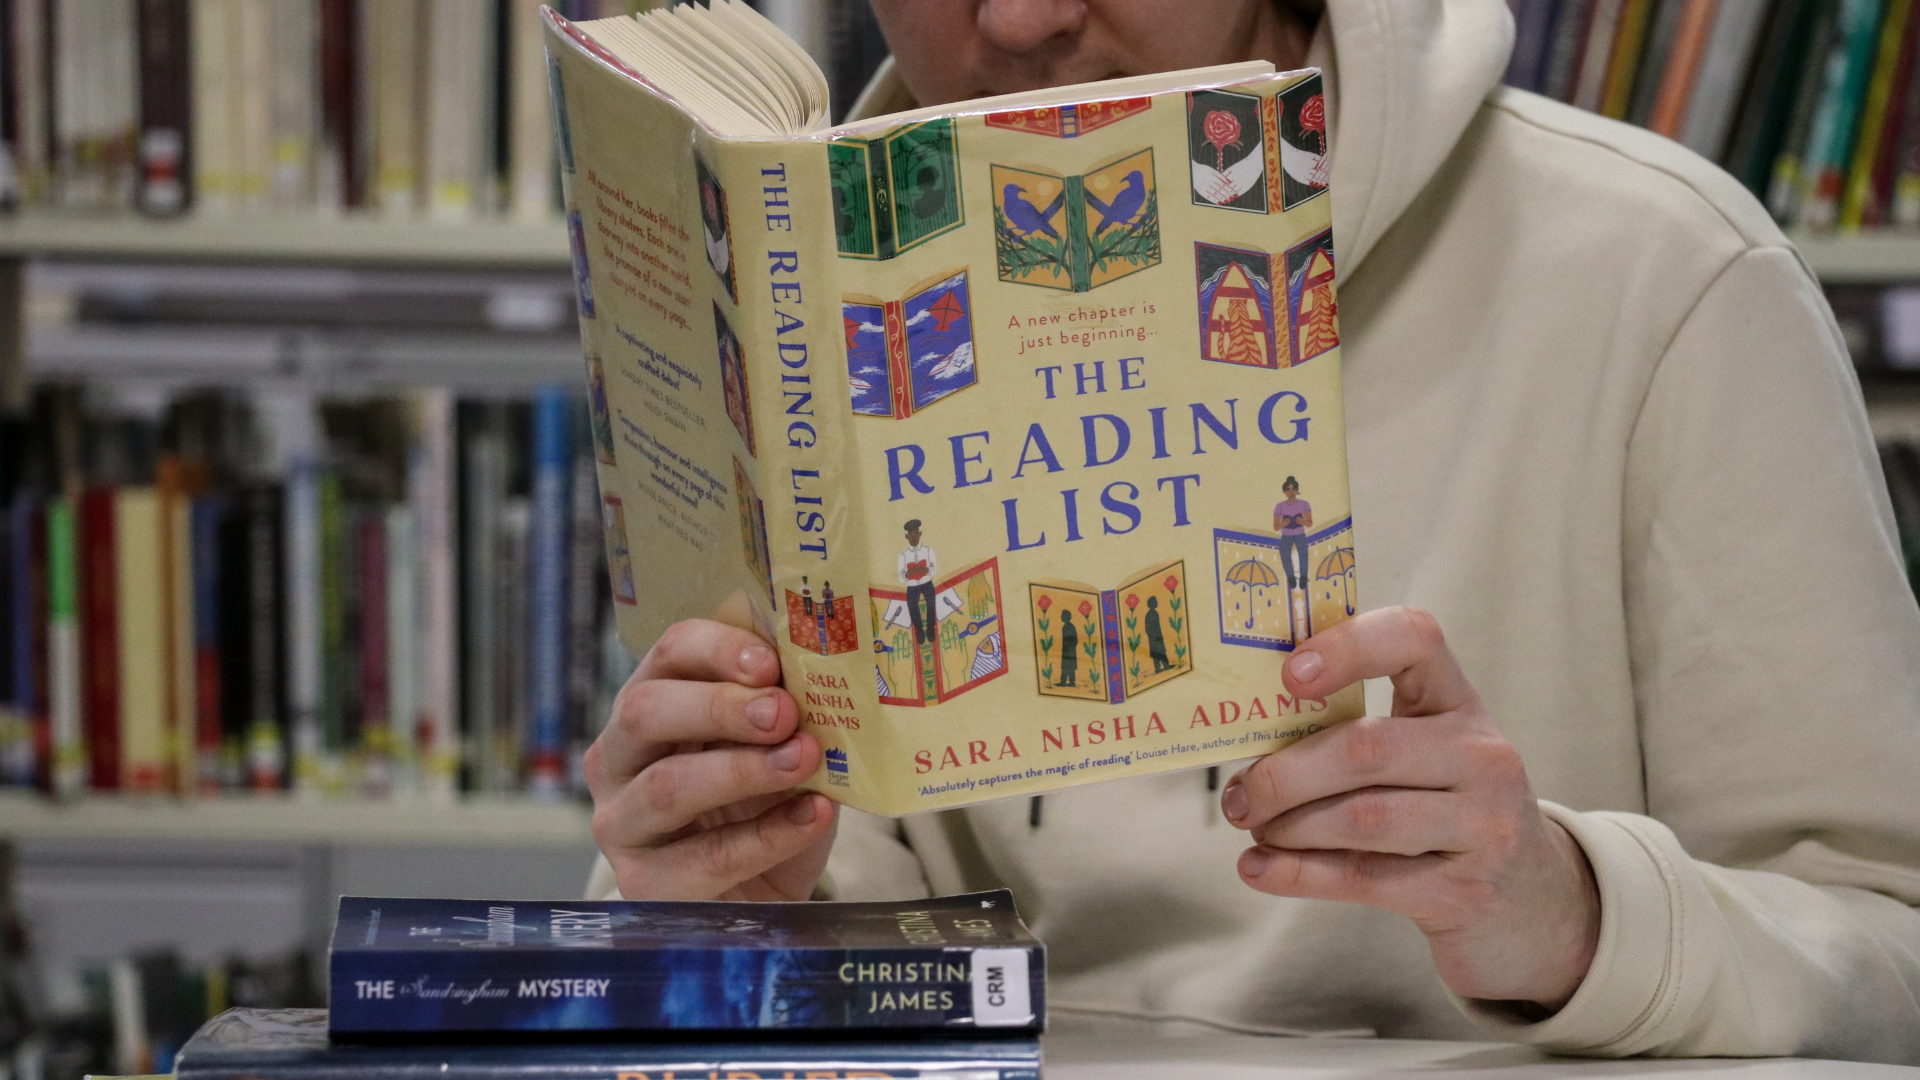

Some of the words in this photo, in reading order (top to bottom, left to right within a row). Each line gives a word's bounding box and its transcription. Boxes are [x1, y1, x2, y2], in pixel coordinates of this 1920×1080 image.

[597, 181, 620, 201] around
[621, 190, 635, 214] her,
[637, 199, 658, 223] books
[659, 212, 677, 235] filled
[678, 225, 690, 243] the
[761, 162, 792, 233] THE
[619, 212, 645, 238] shelves.
[647, 227, 665, 250] Each
[625, 242, 639, 256] into
[641, 251, 668, 272] another
[616, 256, 641, 279] promise
[643, 271, 650, 286] of
[659, 283, 673, 296] new
[639, 291, 647, 303] on
[649, 298, 667, 319] every
[1008, 315, 1021, 329] A
[1028, 314, 1061, 327] new
[1068, 305, 1136, 323] chapter
[1143, 301, 1156, 314] is
[767, 250, 817, 449] READING
[1018, 335, 1053, 355] just
[1060, 325, 1158, 347] beginning...
[1035, 356, 1146, 400] THE
[883, 390, 1312, 502] READING
[679, 457, 691, 469] and
[663, 463, 671, 473] on
[672, 469, 689, 490] every
[689, 481, 705, 499] page
[790, 468, 829, 560] LIST
[1000, 473, 1200, 552] LIST
[806, 672, 849, 690] SARA
[805, 691, 855, 710] NISHA
[805, 711, 860, 730] ADAMS
[914, 735, 1021, 775] SARA
[1041, 711, 1168, 753] NISHA
[1188, 693, 1328, 730] ADAMS
[978, 772, 1023, 787] captures
[1025, 768, 1042, 778] the
[1045, 762, 1076, 776] magic
[1078, 758, 1090, 769] of
[1136, 746, 1168, 760] Louise
[1171, 742, 1199, 755] Hare,
[1202, 737, 1236, 750] author
[1238, 732, 1250, 744] of
[1252, 730, 1271, 742] This
[1274, 726, 1304, 739] Lovely
[828, 771, 849, 780] Harper
[828, 779, 850, 787] Collins
[355, 980, 395, 1000] THE
[518, 978, 611, 998] MYSTERY
[839, 963, 971, 983] CHRISTIN
[987, 965, 1007, 1007] CRM
[869, 990, 954, 1013] JAMES
